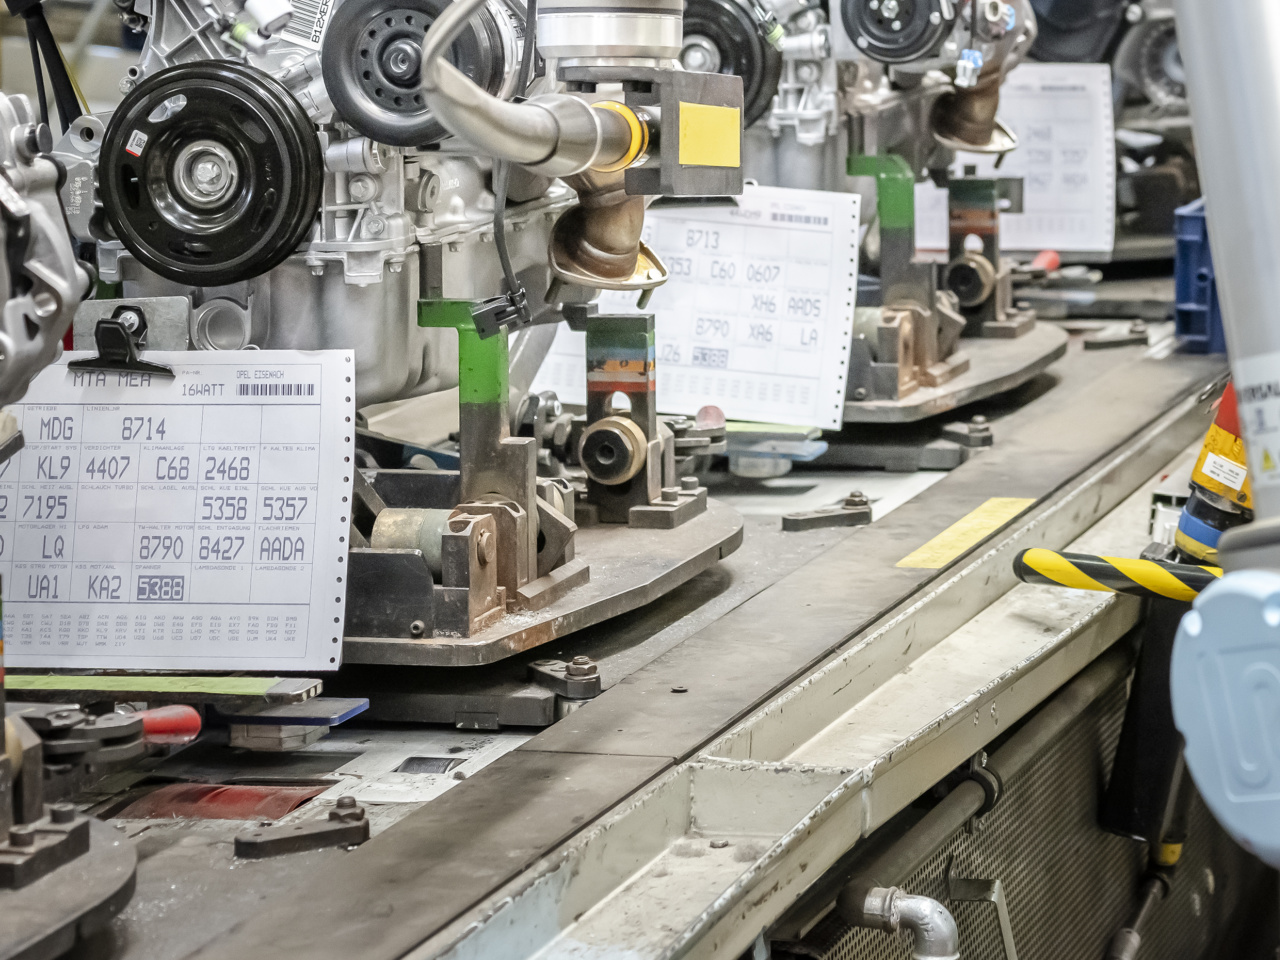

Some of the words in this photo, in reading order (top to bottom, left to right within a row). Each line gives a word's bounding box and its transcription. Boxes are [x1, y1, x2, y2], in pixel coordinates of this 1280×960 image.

[685, 228, 720, 249] 8713
[710, 262, 736, 280] C60
[800, 327, 818, 346] LA
[73, 372, 106, 388] MTA
[118, 372, 151, 388] MEA
[236, 370, 251, 380] OPEL
[254, 370, 285, 380] EISENACH
[182, 384, 225, 396] 16WATT
[39, 416, 74, 441] MDG
[121, 416, 166, 441] 8714
[36, 455, 71, 480] KL9
[86, 456, 131, 480] 4407
[156, 456, 190, 481] C68
[205, 456, 250, 481] 2468
[22, 495, 68, 519] 7195
[201, 496, 247, 521] 5358
[262, 496, 308, 521] 5357
[42, 534, 65, 559] LQ
[139, 535, 184, 560] 8790
[199, 536, 245, 561] 8427
[259, 536, 305, 561] AADA
[27, 574, 59, 599] UA1
[87, 575, 122, 600] KA2
[138, 576, 185, 600] 5388
